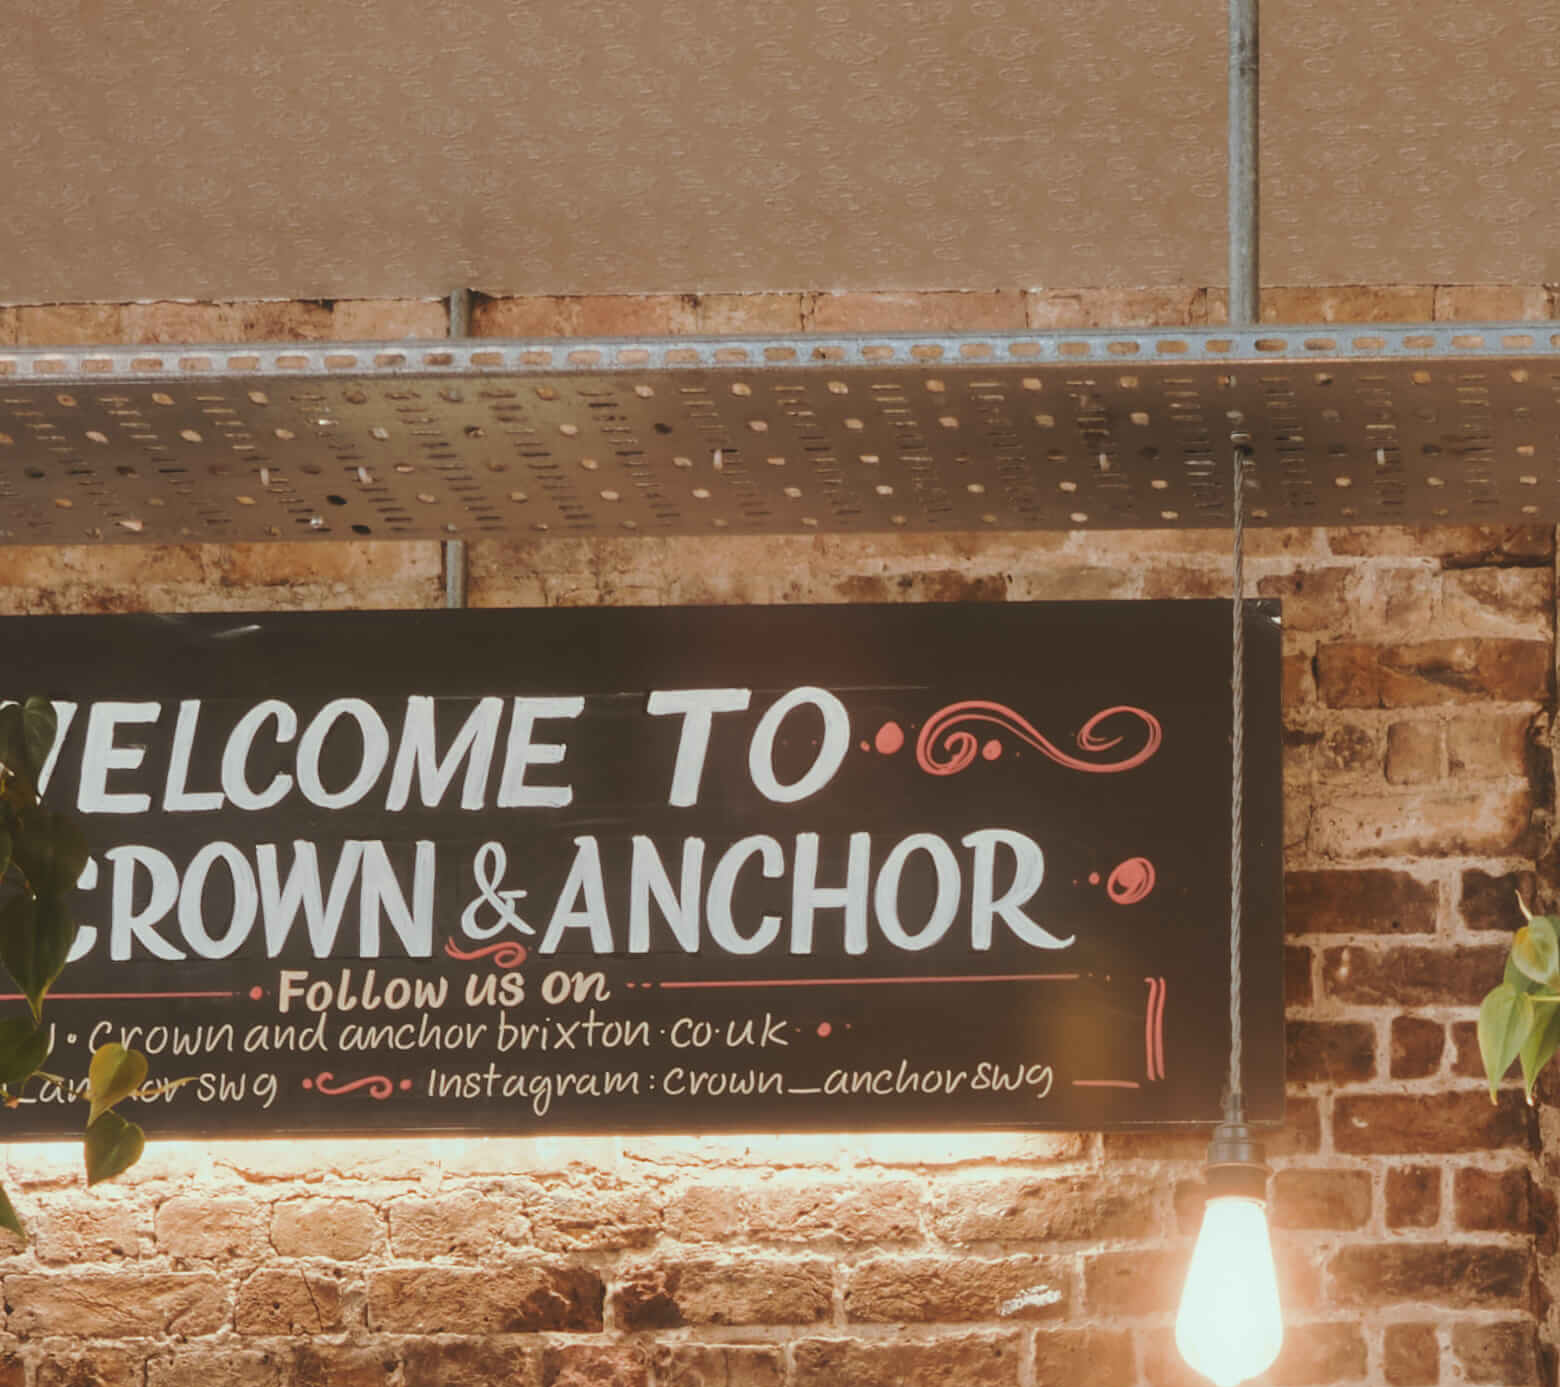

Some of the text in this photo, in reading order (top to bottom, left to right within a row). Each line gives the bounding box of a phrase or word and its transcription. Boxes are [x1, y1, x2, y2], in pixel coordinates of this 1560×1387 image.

[647, 687, 850, 807] TO
[461, 829, 1075, 956] & ANCHOR
[278, 969, 610, 1013] Follow us on
